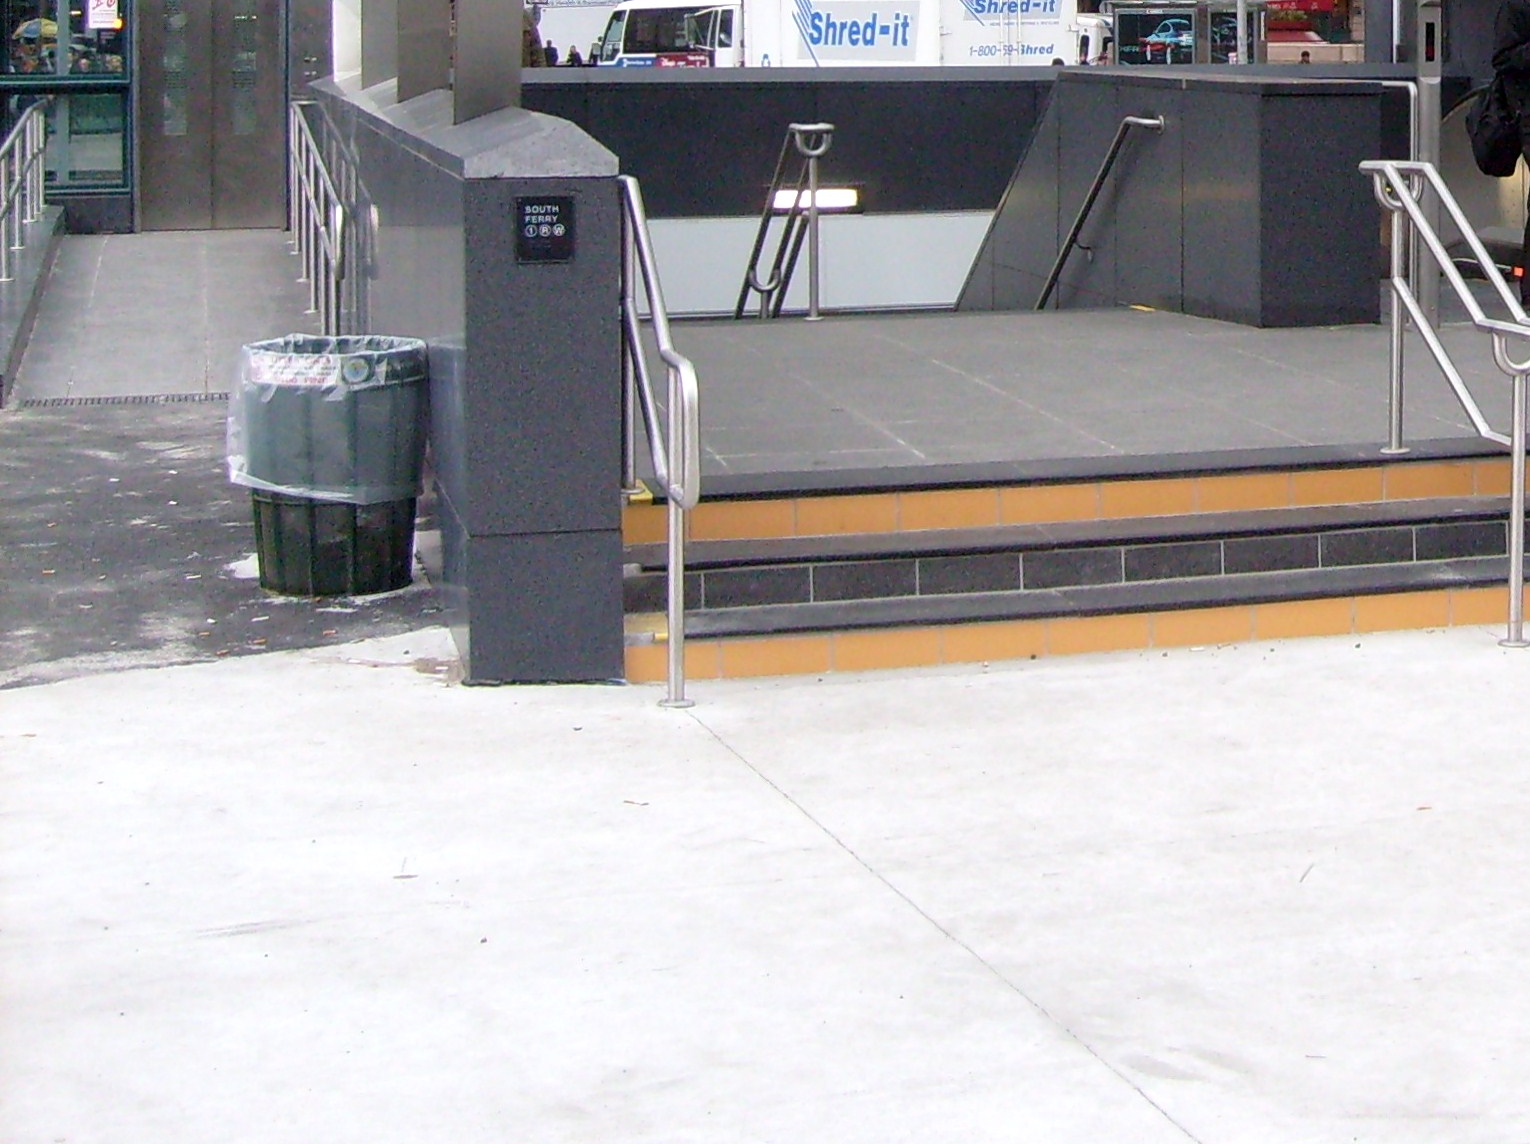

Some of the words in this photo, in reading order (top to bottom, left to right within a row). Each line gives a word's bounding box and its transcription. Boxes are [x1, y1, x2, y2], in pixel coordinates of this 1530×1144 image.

[808, 11, 910, 46] Shred-it
[524, 205, 560, 214] SOUTH
[524, 214, 559, 223] FERRY
